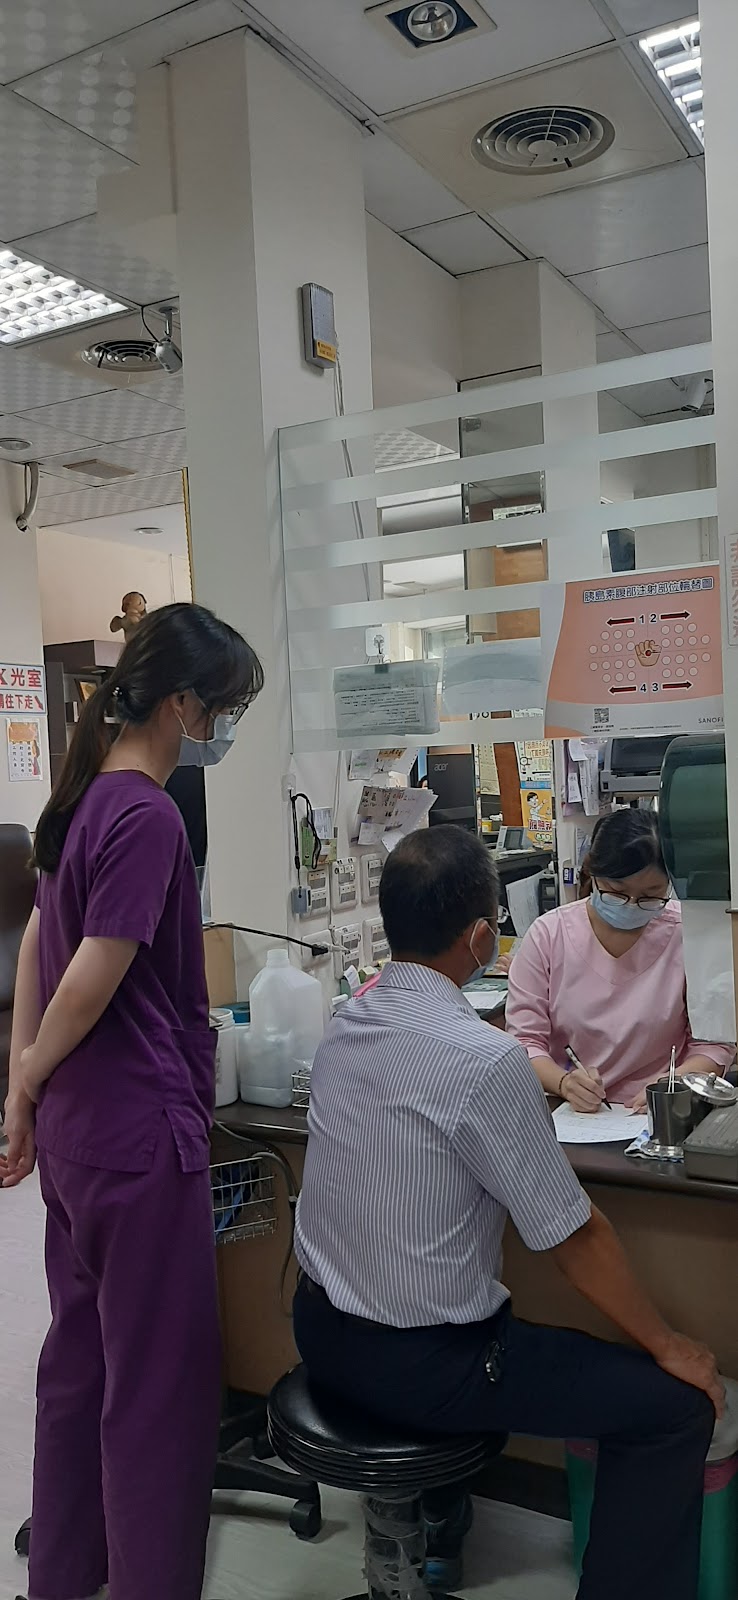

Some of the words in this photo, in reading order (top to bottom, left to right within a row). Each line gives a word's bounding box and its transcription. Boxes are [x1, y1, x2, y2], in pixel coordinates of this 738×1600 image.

[639, 614, 645, 624] 1
[650, 613, 657, 623] 2
[640, 683, 647, 693] 4
[652, 682, 659, 692] 3
[434, 762, 449, 772] acer
